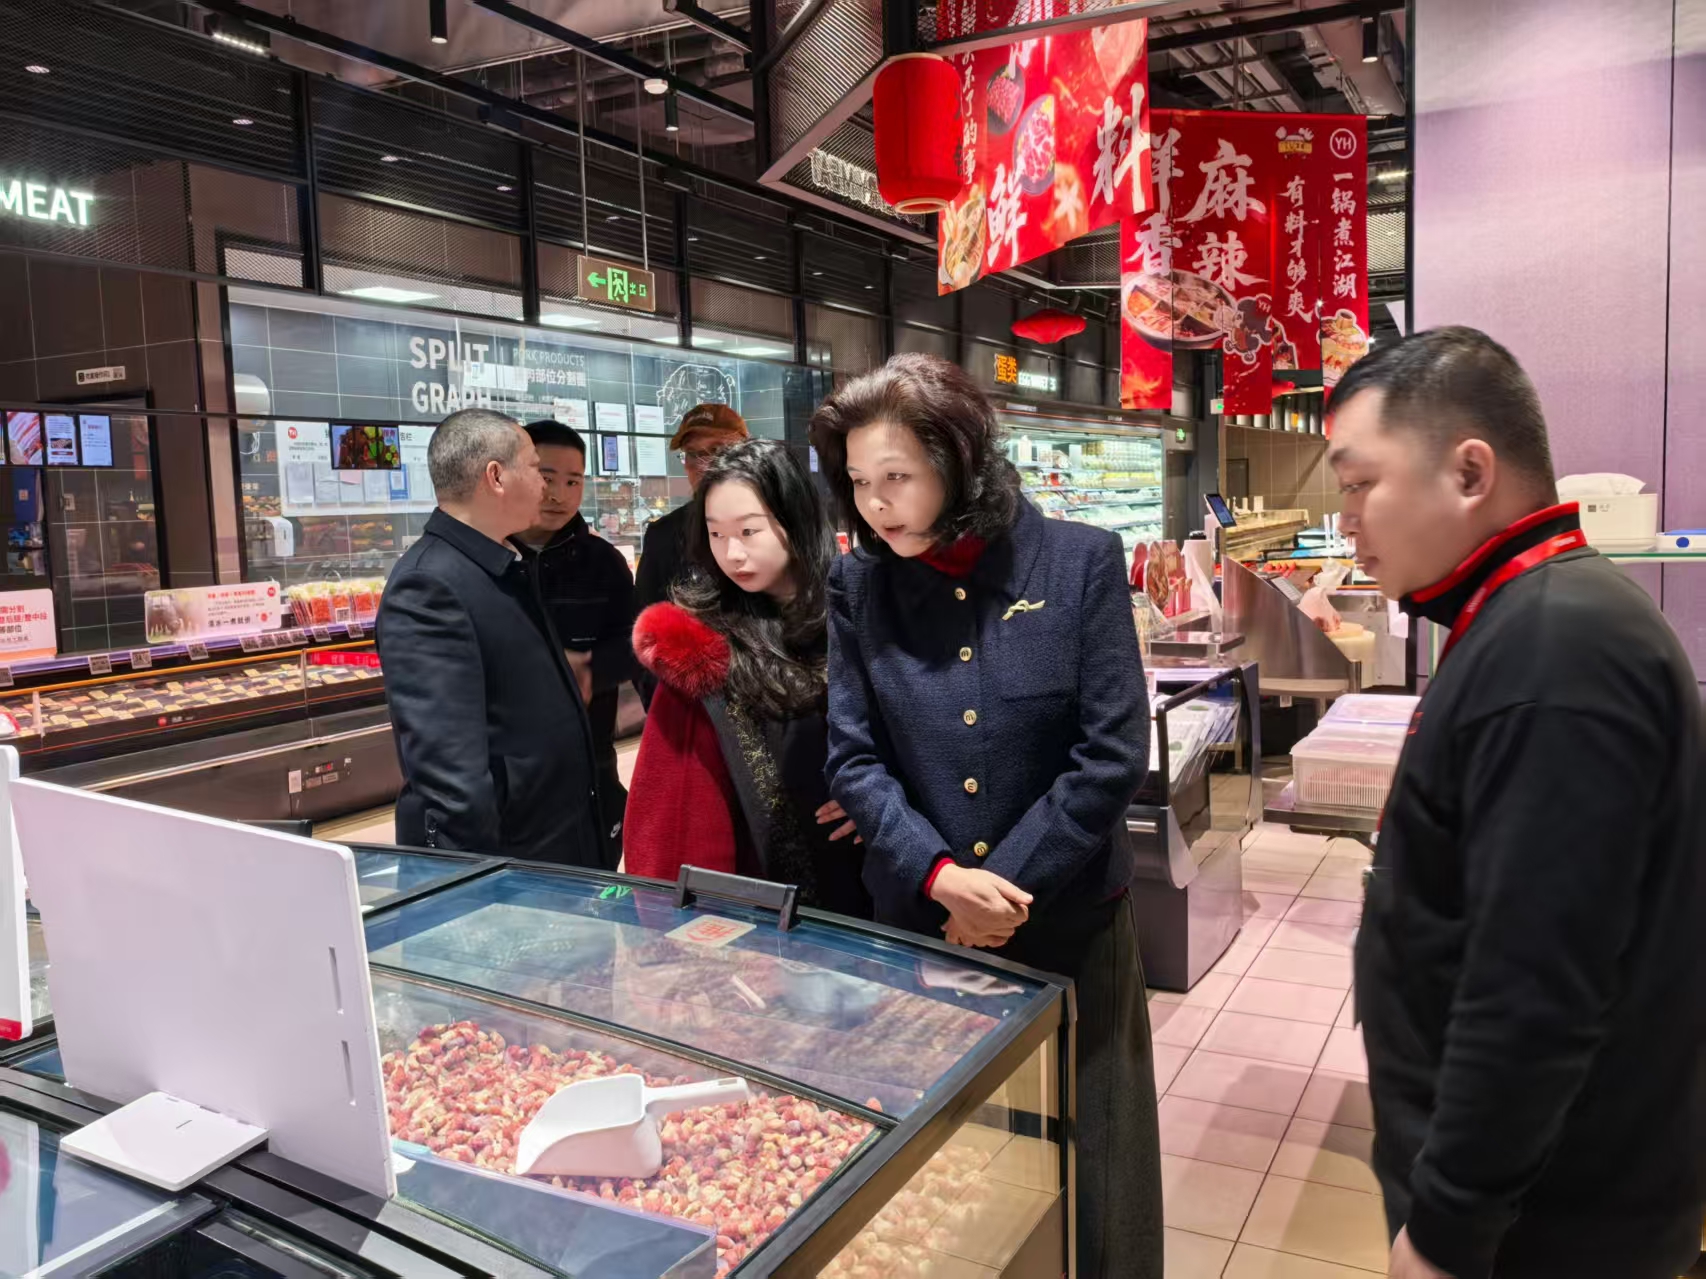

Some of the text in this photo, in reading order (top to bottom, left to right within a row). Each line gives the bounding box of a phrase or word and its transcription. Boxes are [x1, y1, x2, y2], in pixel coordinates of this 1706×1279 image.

[0, 180, 94, 226] MEAT
[1174, 138, 1269, 292] 麻辣
[1277, 175, 1313, 323] 有料才够爽
[1331, 172, 1356, 299] 一锅煮江湖
[629, 282, 647, 297] 出口
[409, 336, 489, 374] SPLIT
[539, 350, 585, 367] PRODUCTS
[997, 354, 1017, 384] 蛋类
[411, 381, 491, 414] GRAPH
